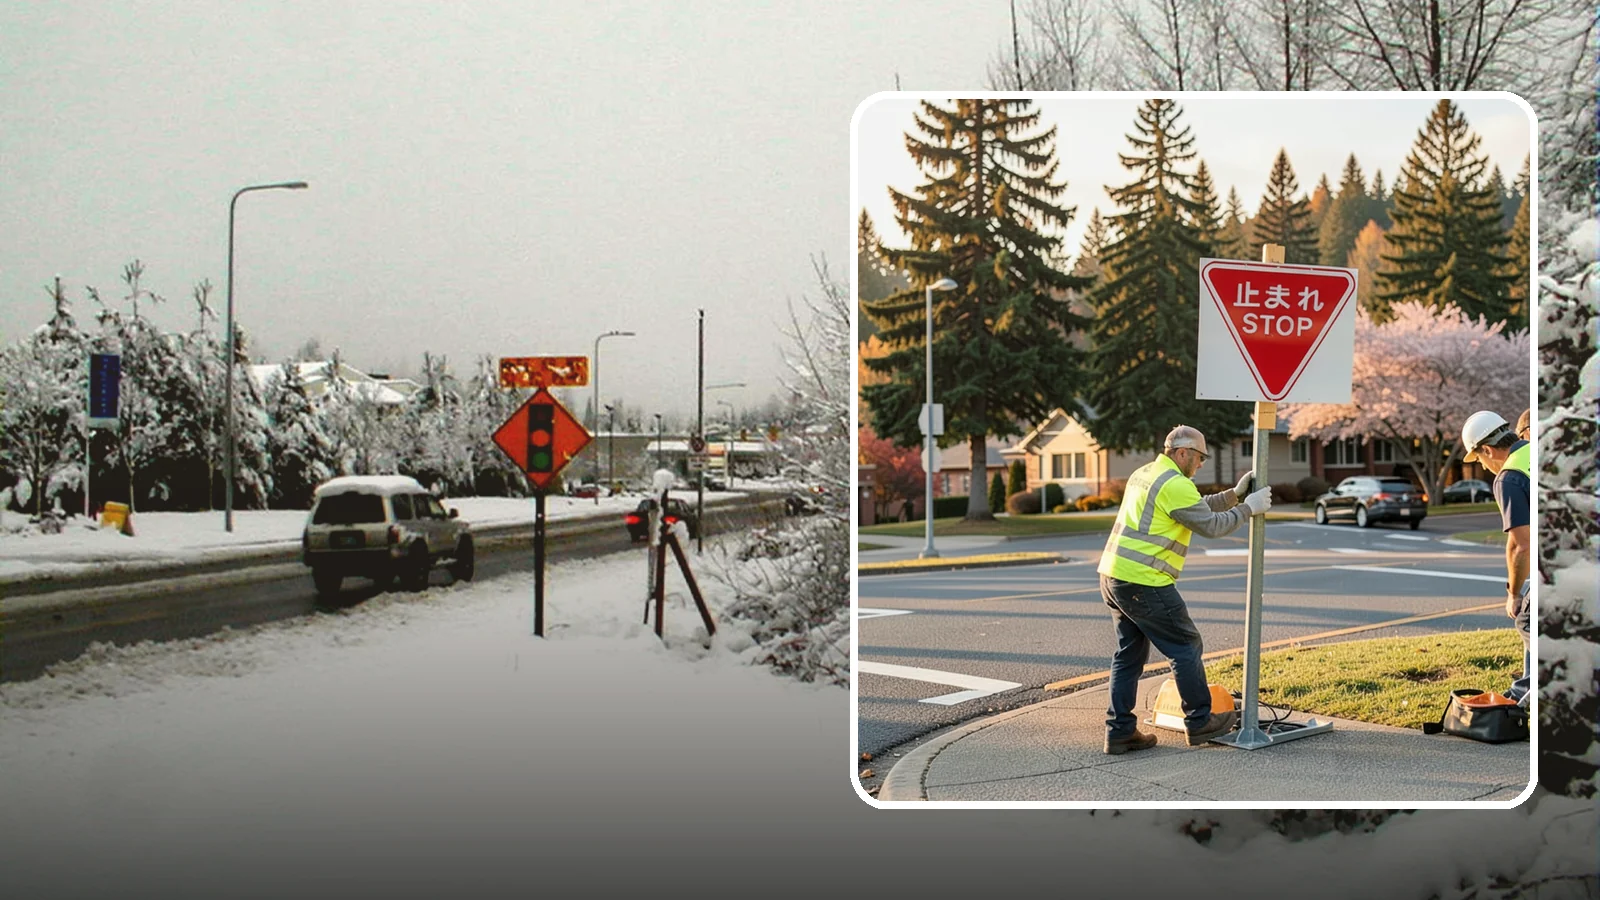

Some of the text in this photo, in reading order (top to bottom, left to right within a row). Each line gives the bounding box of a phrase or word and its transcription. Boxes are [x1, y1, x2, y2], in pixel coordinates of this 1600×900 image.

[1233, 281, 1324, 312] 止まれ
[1242, 312, 1313, 336] STOP
